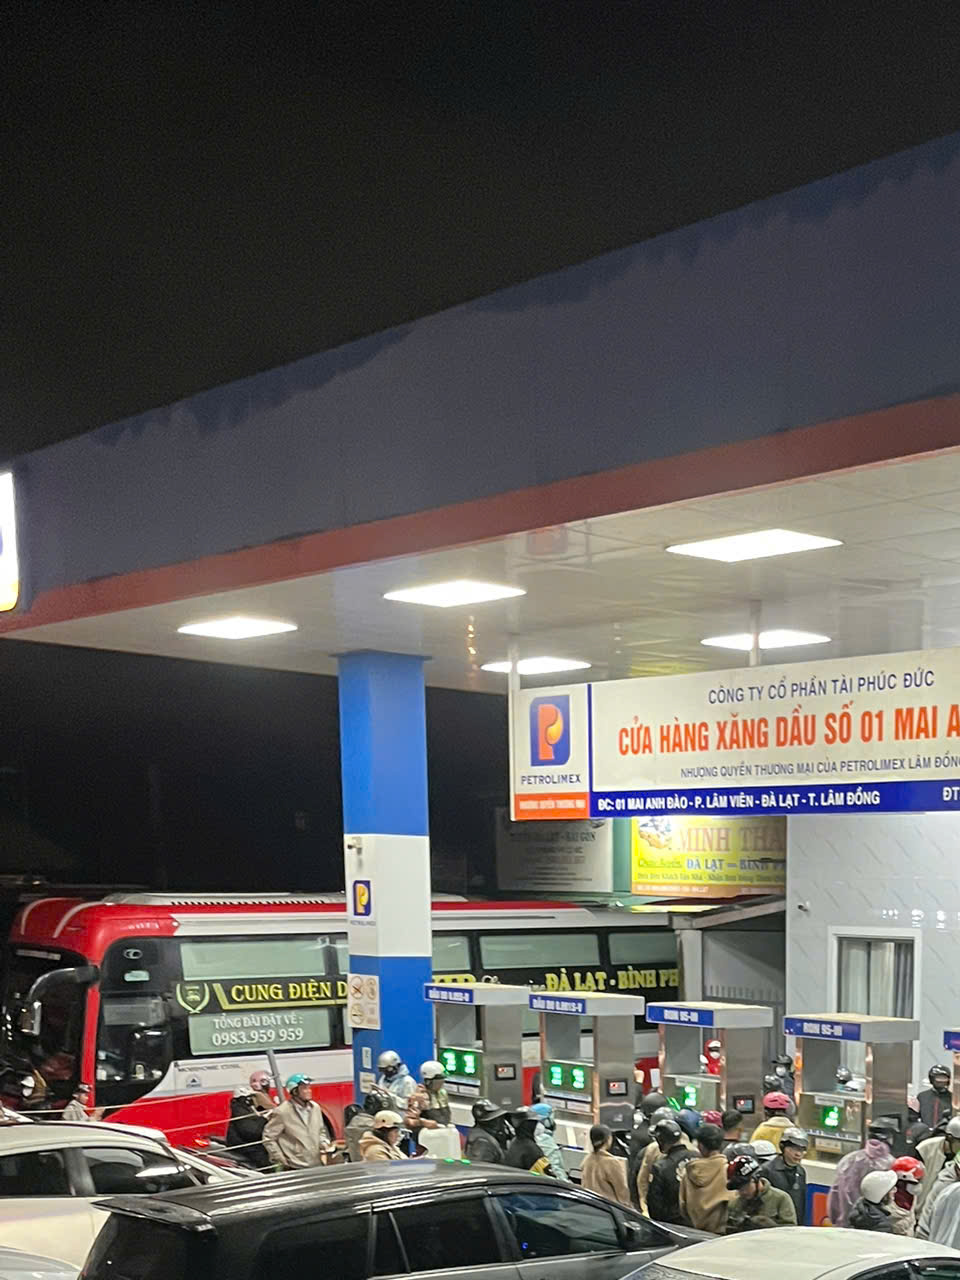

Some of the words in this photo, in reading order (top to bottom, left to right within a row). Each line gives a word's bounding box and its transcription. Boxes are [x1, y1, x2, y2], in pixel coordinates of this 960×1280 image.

[708, 685, 744, 704] CÔNG
[748, 686, 764, 701] TY
[768, 675, 787, 700] CỔ
[790, 675, 827, 698] PHẦN
[831, 675, 853, 695] TÀI
[857, 670, 898, 693] PHÚC
[903, 667, 935, 688] ĐỨC
[619, 715, 653, 756] CỬA
[660, 716, 709, 753] HÀNG
[716, 711, 769, 750] XĂNG
[776, 703, 816, 748] DẦU
[824, 700, 854, 745] SỐ
[860, 710, 884, 742] 01
[894, 705, 938, 741] MAI
[840, 758, 905, 773] PETROLIMEX
[908, 755, 932, 770] LÂM
[521, 773, 582, 785] PETROLIMEX
[597, 798, 615, 811] ĐC:
[616, 798, 626, 811] 01
[628, 797, 644, 810] MAI
[645, 796, 663, 810] ANH
[663, 792, 688, 810] ĐÀO
[706, 791, 727, 808] LÂM
[728, 792, 754, 808] VIÊN
[761, 790, 779, 807] ĐÀ
[780, 793, 800, 808] LẠT
[820, 789, 844, 806] LÂM
[846, 786, 880, 806] ĐỒNG
[545, 968, 571, 992] ĐÀ
[617, 965, 657, 990] BÌNH
[231, 984, 284, 1002] CUNG
[288, 979, 331, 1002] ĐIỆN
[213, 1012, 241, 1029] TỔNG
[803, 1022, 821, 1034] RON
[212, 1029, 276, 1046] 0983.959
[280, 1027, 304, 1041] 959
